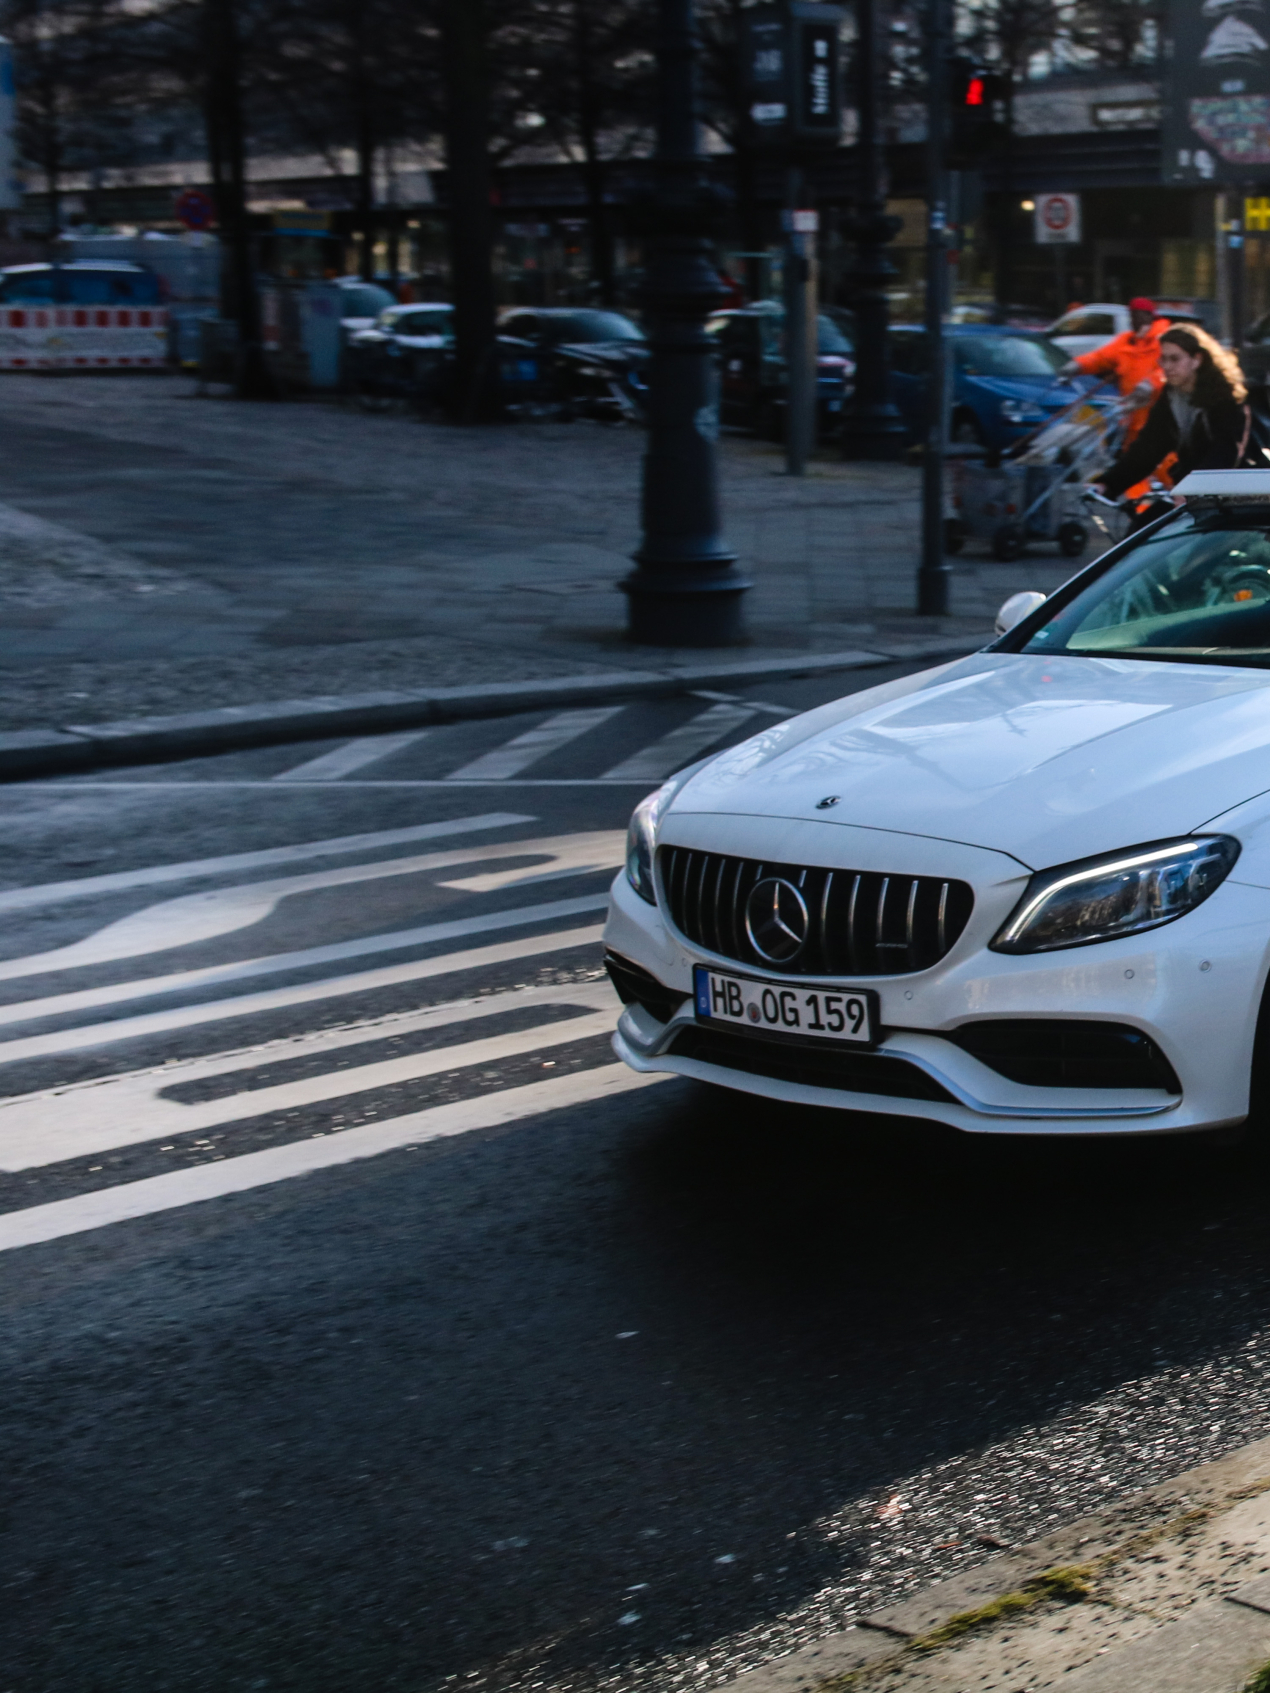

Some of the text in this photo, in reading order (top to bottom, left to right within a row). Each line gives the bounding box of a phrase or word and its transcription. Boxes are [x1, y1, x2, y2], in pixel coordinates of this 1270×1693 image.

[711, 977, 865, 1034] HB OG 159
